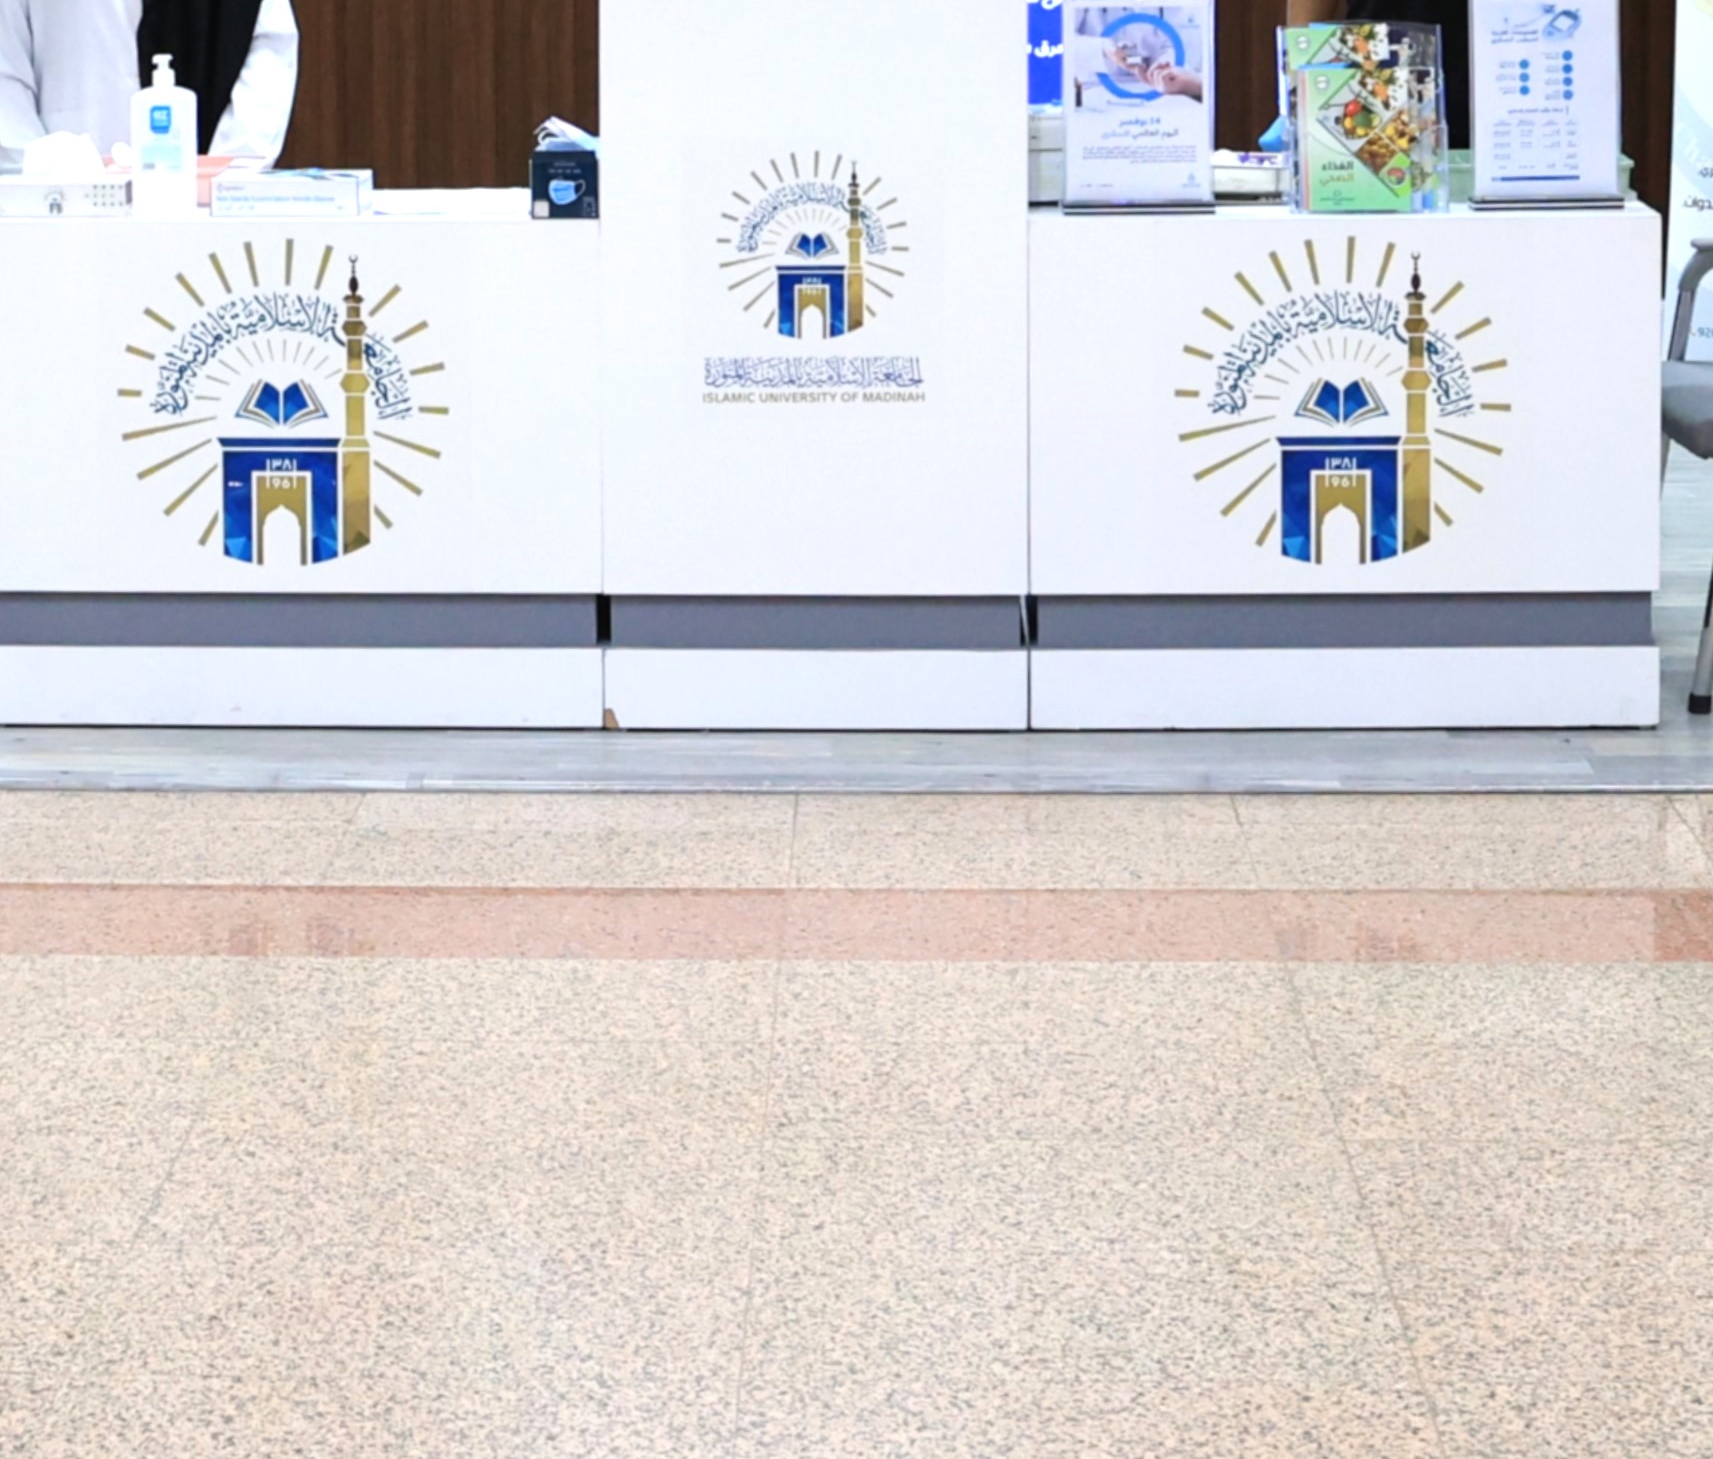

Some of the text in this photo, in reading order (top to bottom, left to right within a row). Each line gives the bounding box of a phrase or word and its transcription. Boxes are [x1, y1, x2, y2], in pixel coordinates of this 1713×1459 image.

[703, 392, 926, 403] ISLAMIC UNIVERSITY OF MADINAH
